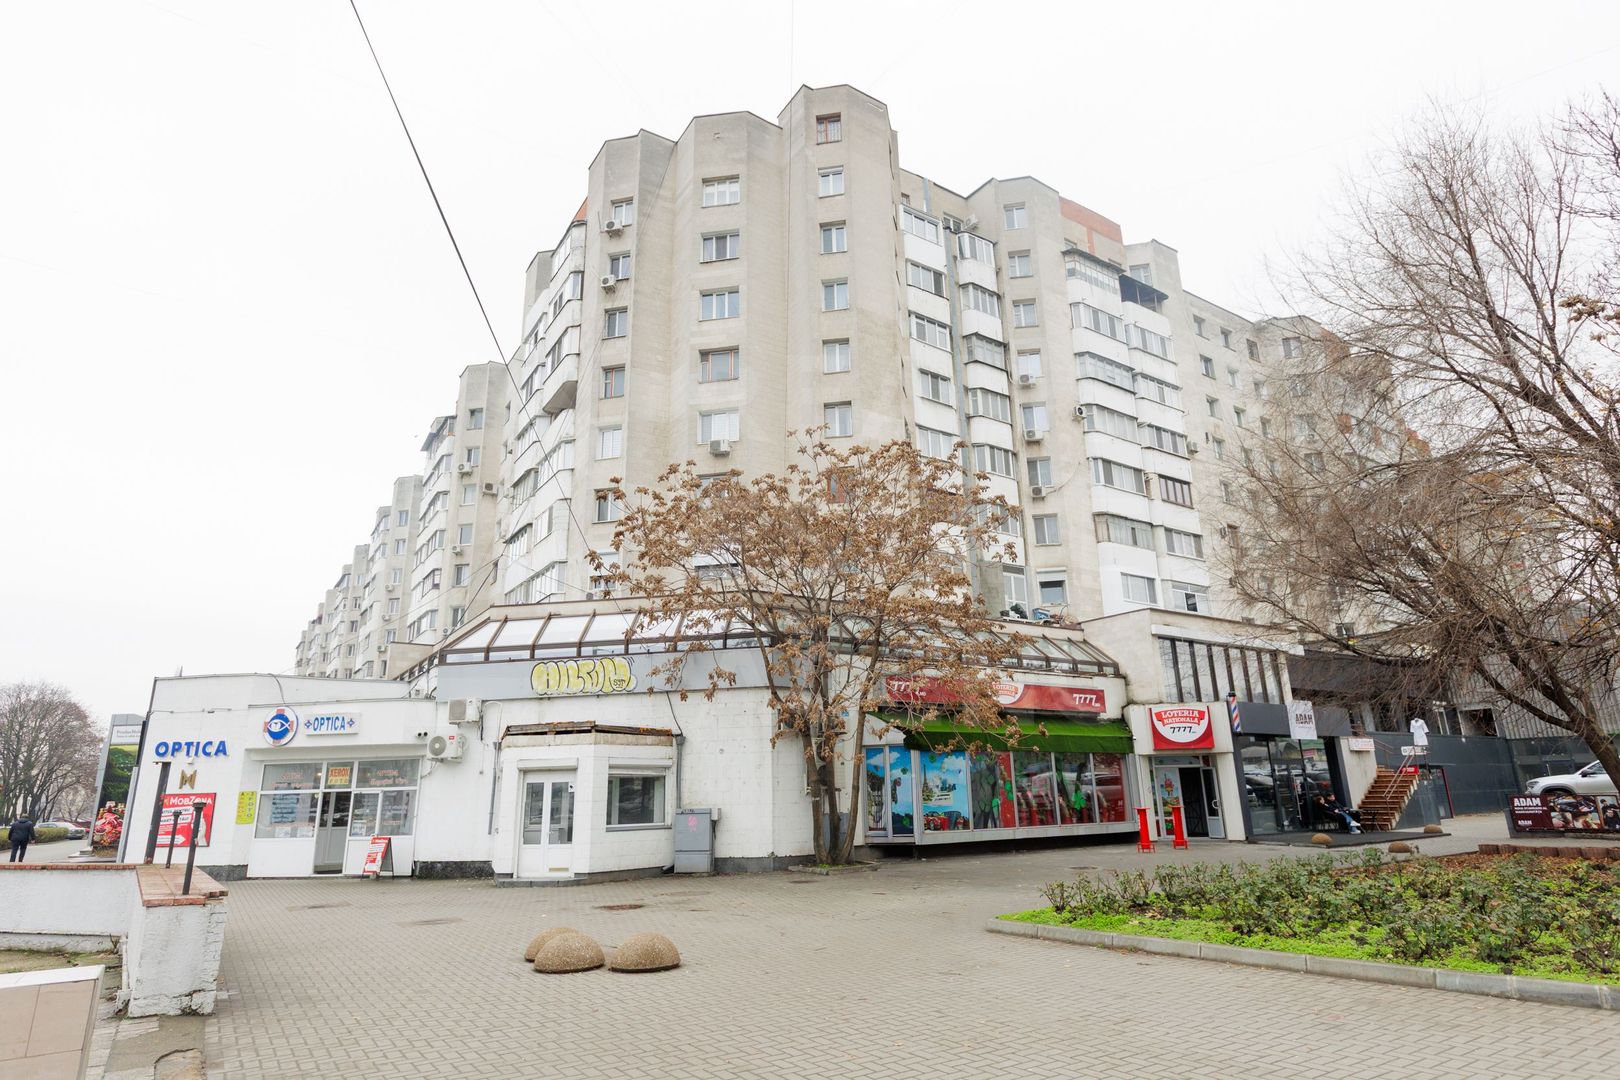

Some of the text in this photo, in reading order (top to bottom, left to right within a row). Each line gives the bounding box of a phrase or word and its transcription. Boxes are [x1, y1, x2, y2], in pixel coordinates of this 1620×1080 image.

[1161, 710, 1200, 719] LOTERIA
[312, 716, 346, 731] OPTICA
[155, 740, 228, 757] OPTICA
[1514, 797, 1541, 806] ADAM
